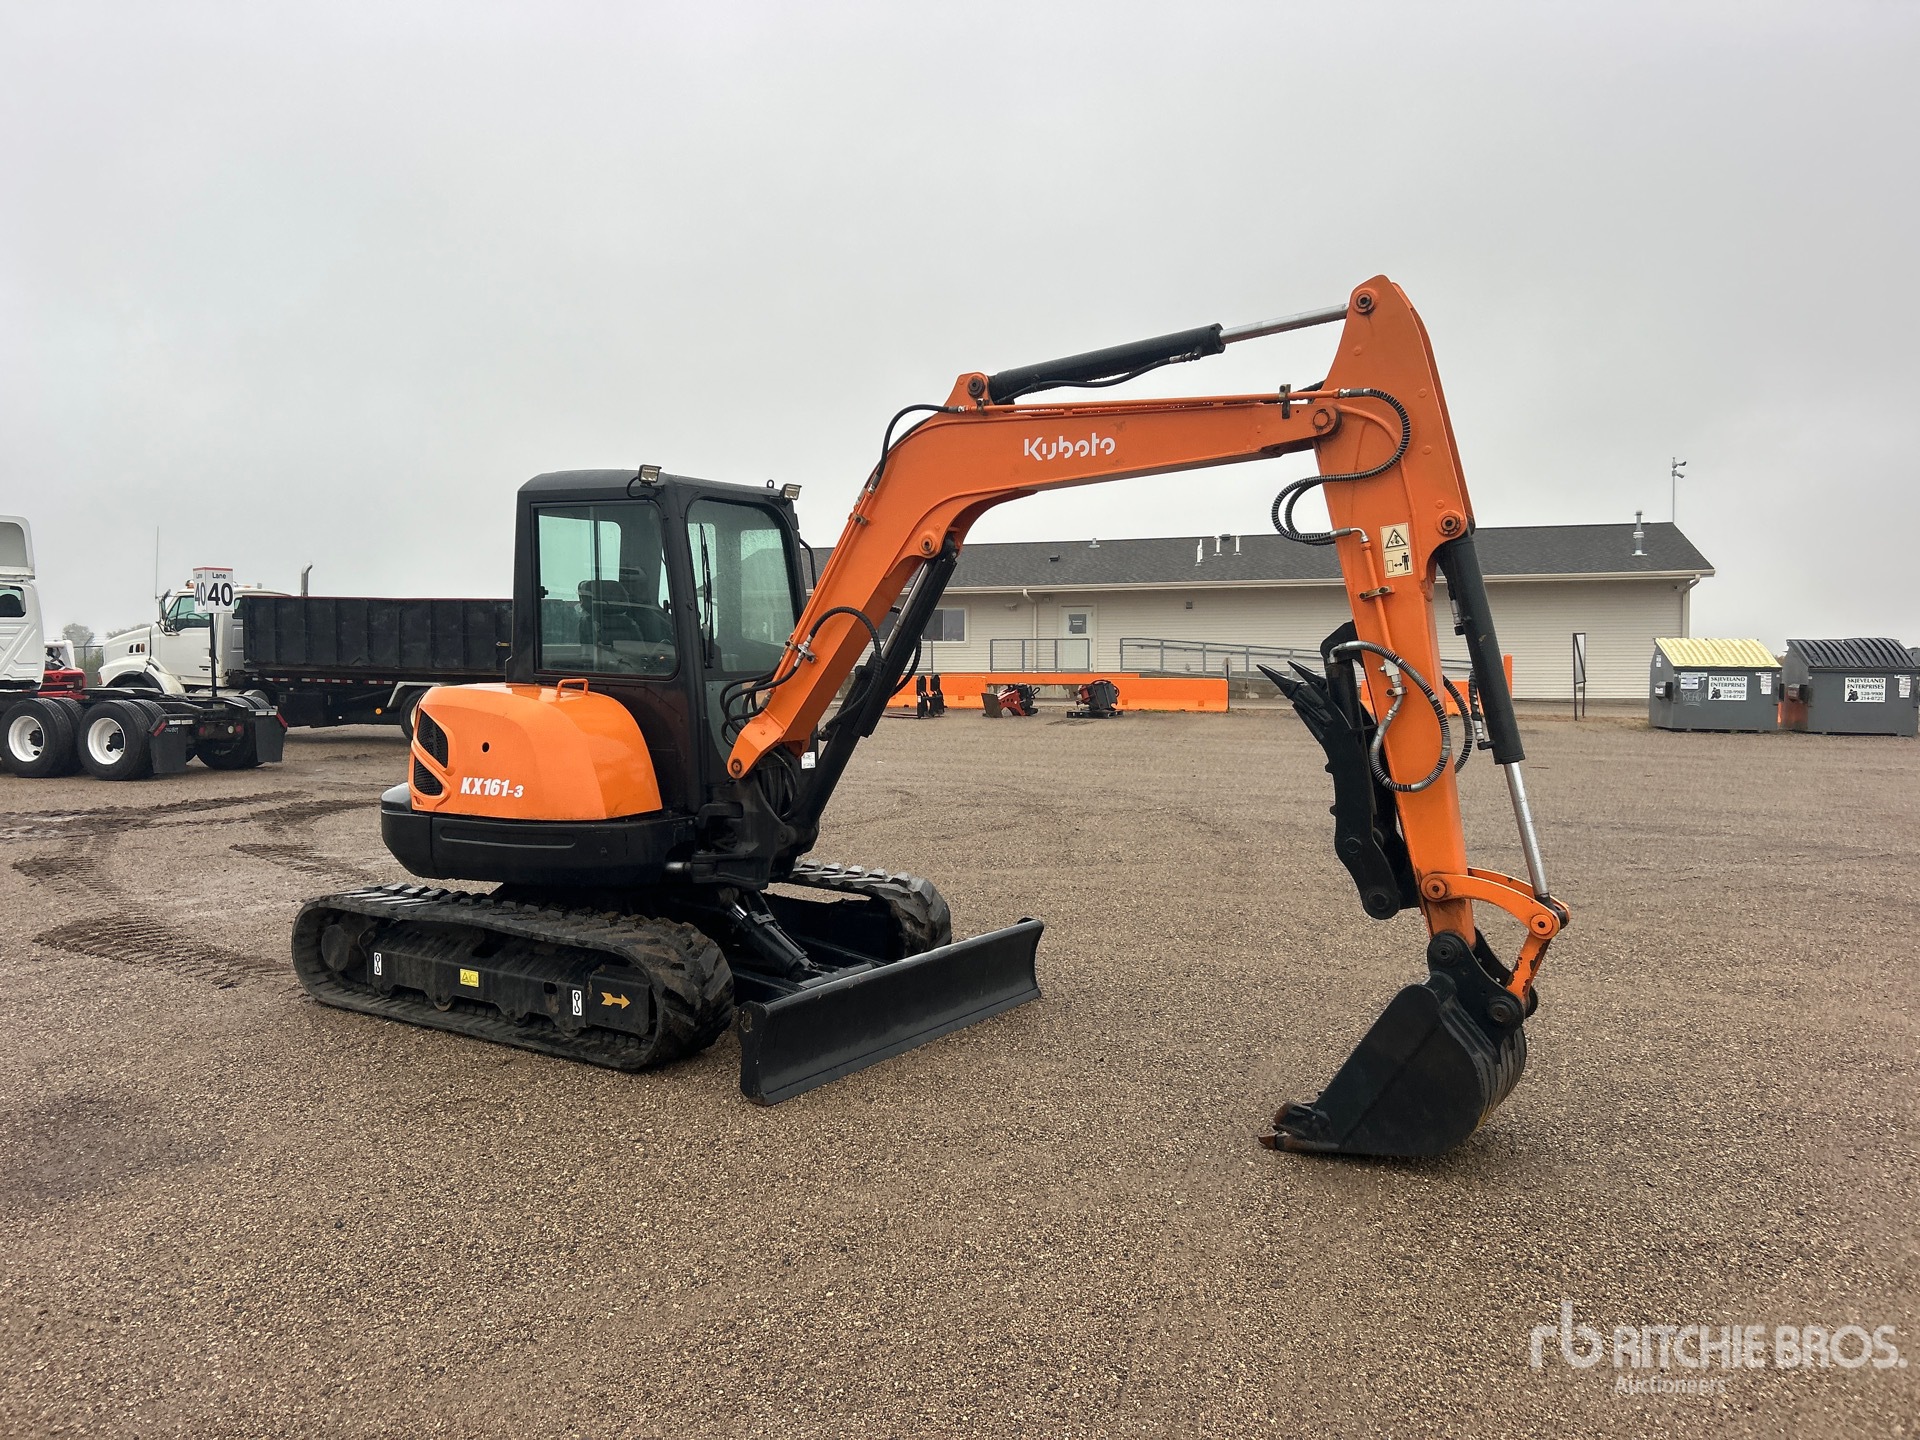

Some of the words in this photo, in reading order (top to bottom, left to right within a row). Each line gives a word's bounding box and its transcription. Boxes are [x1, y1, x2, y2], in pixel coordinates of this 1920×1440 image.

[1023, 432, 1116, 461] Kubota
[195, 582, 206, 606] 40
[207, 582, 233, 606] 40
[460, 777, 524, 798] KX161-3
